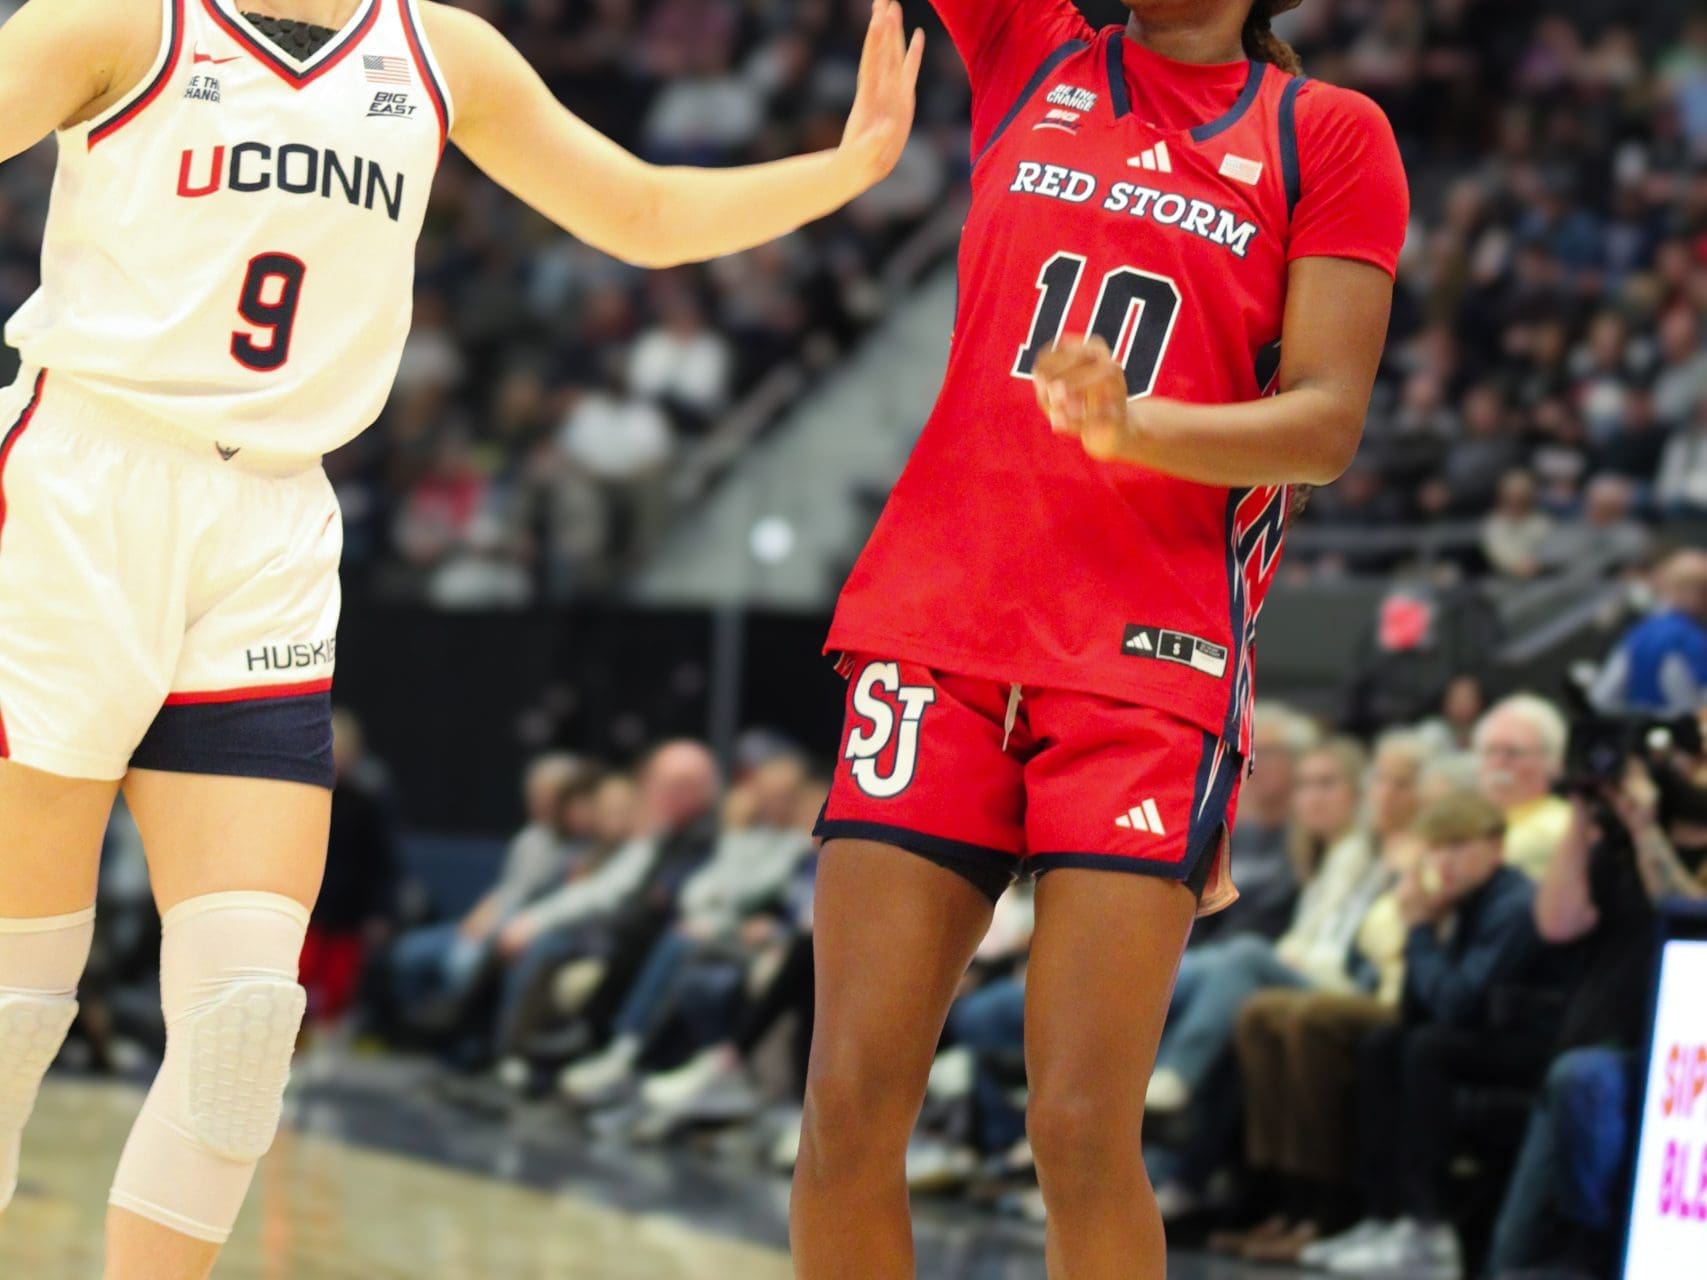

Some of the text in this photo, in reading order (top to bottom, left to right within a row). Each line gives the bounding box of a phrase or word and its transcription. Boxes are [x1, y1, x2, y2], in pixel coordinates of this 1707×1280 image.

[183, 87, 221, 104] HANG
[369, 102, 417, 115] EAST
[374, 91, 408, 104] BIG
[1045, 91, 1096, 112] CHANGE
[176, 141, 404, 222] UCONN
[1010, 161, 1258, 260] RED STORM
[229, 251, 307, 372] 9
[1010, 250, 1182, 403] 10
